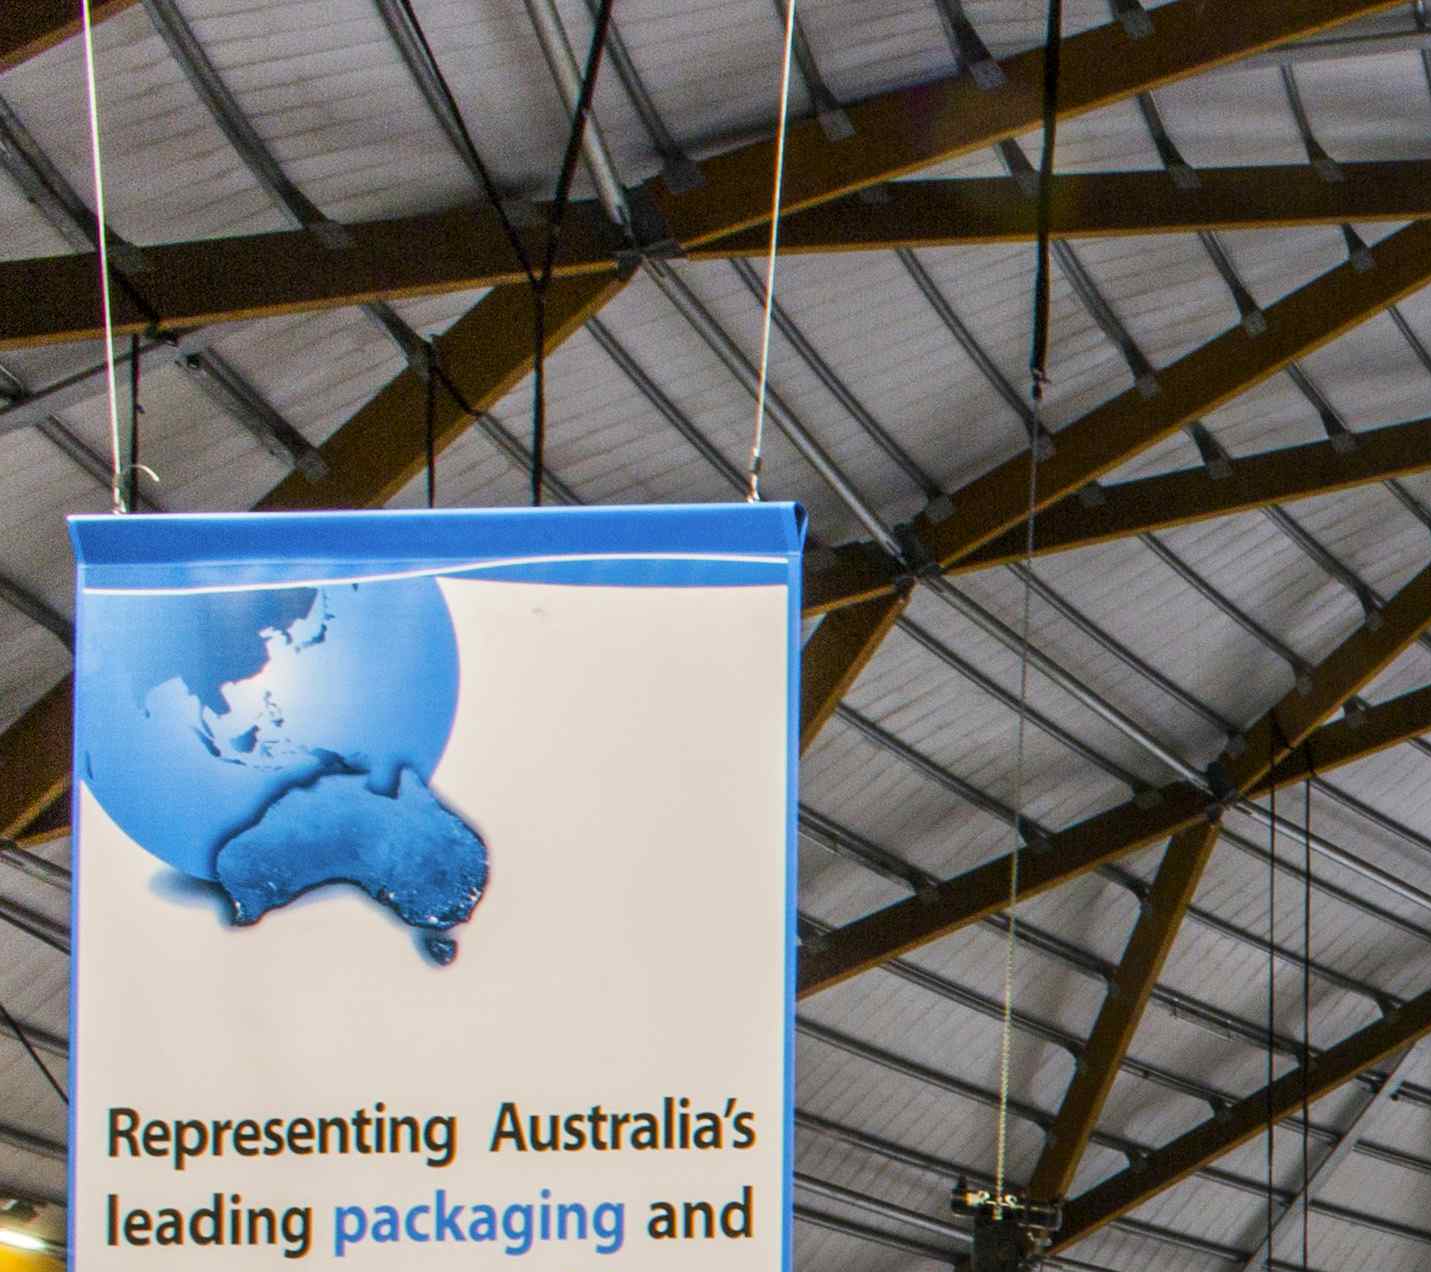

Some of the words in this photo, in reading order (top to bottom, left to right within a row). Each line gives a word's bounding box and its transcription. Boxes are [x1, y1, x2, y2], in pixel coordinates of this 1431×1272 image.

[107, 1102, 457, 1170] Representing
[489, 1098, 756, 1152] Australia's
[106, 1194, 313, 1259] leading
[334, 1189, 625, 1256] packaging
[647, 1186, 754, 1239] and
